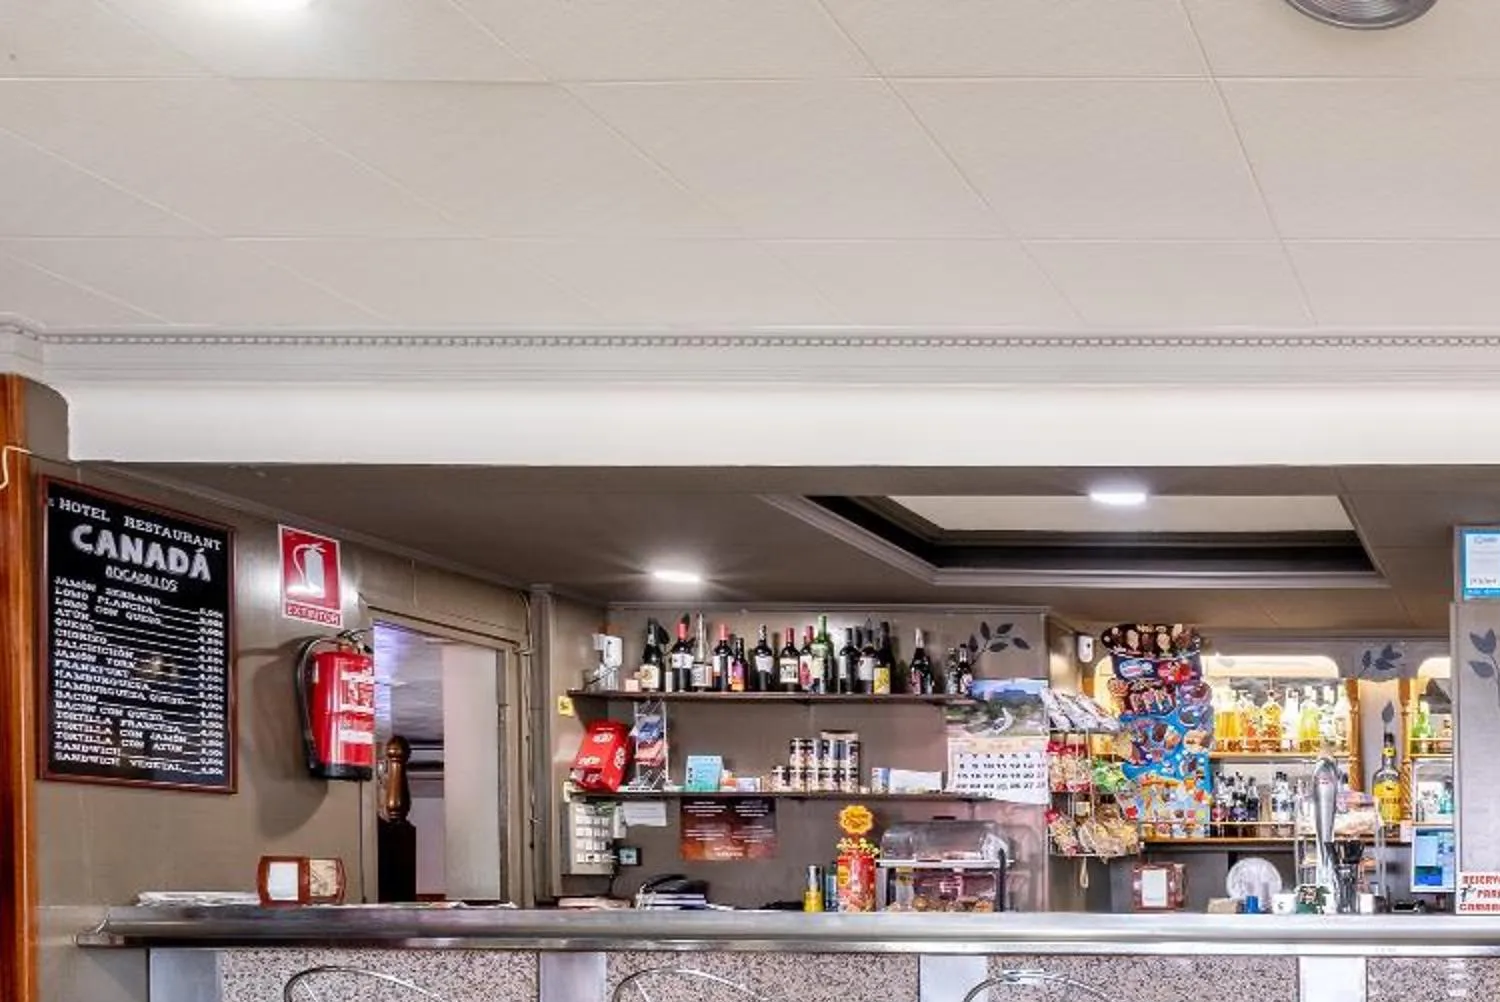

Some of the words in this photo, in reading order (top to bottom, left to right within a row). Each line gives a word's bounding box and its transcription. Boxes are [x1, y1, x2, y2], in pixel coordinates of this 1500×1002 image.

[59, 497, 111, 522] HOTEL
[123, 515, 222, 551] RESTAURANT
[70, 523, 212, 582] CANADÁ
[55, 586, 89, 600] LOMO
[97, 595, 155, 614] PLANCHA
